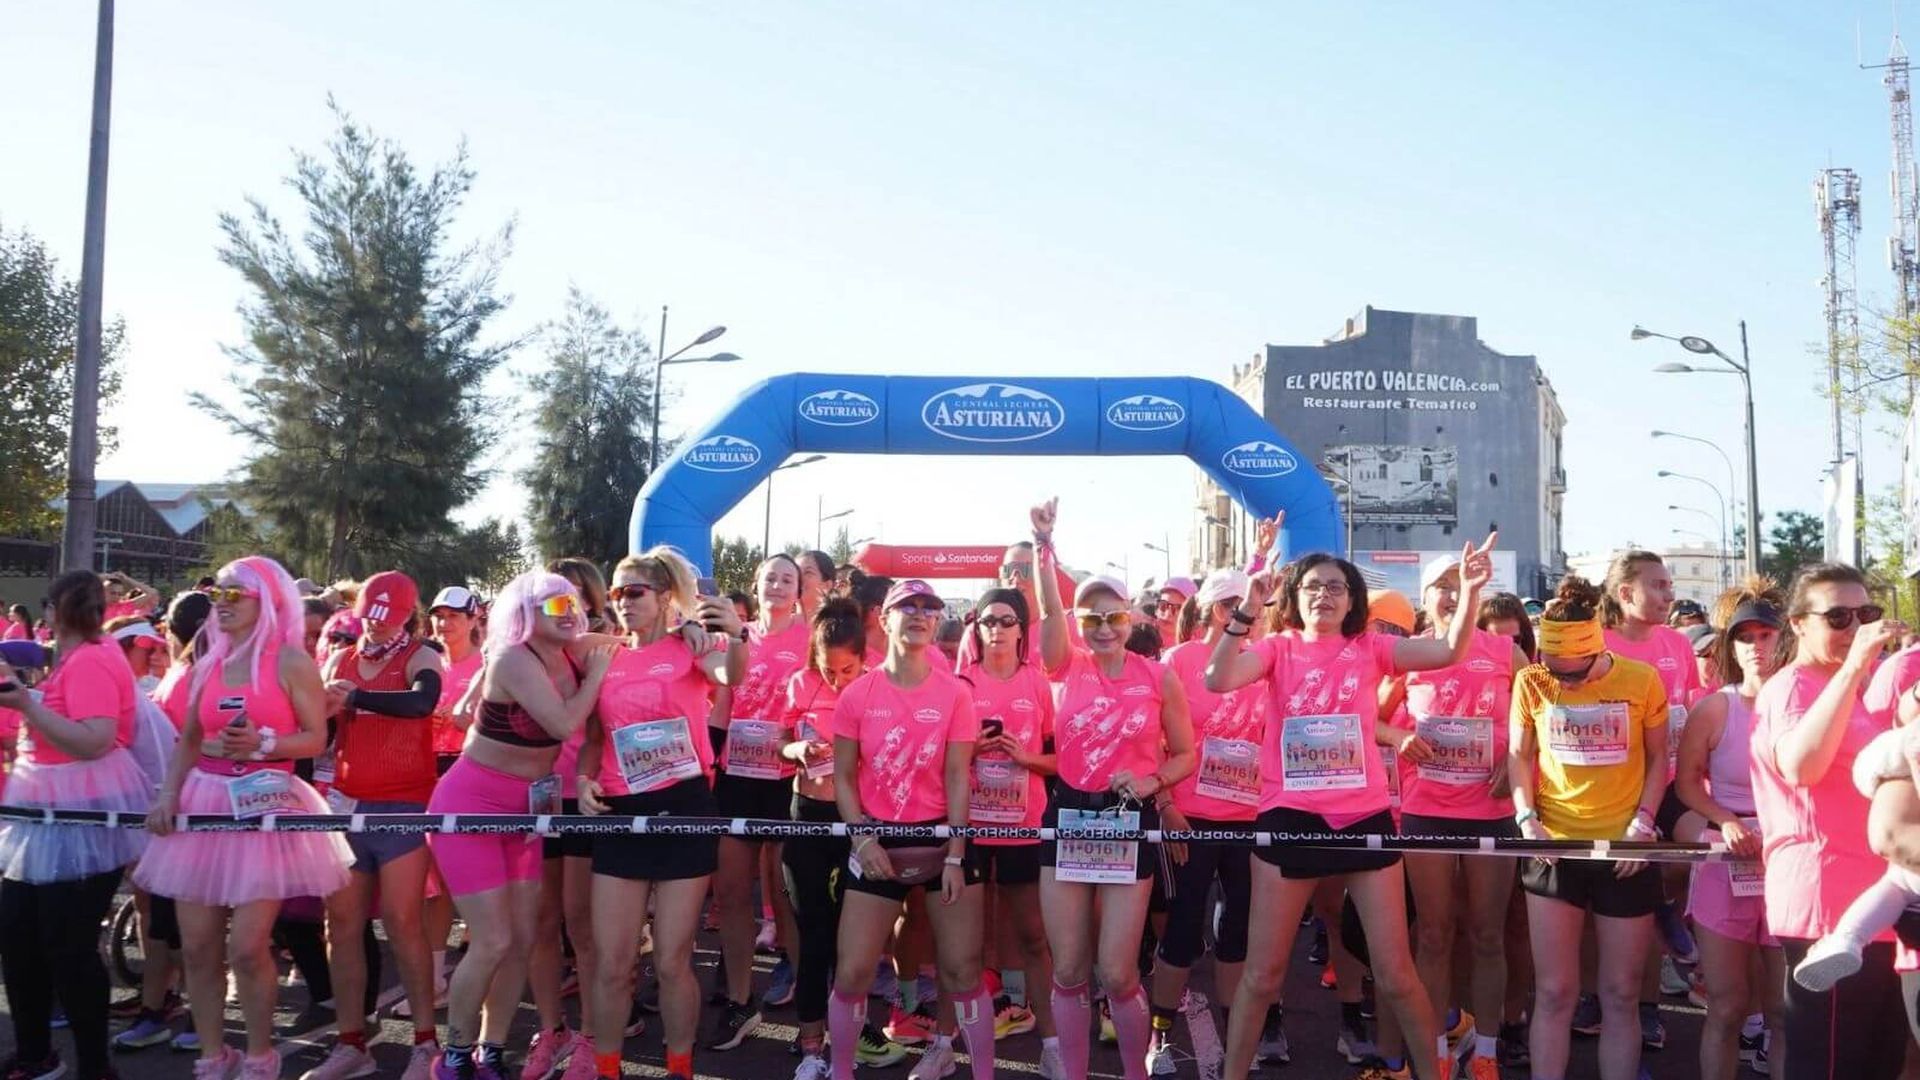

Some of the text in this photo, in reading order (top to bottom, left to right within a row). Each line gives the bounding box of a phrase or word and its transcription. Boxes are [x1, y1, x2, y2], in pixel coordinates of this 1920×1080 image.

[1286, 370, 1500, 392] EL PUERTO VALENCIA.com
[805, 401, 873, 417] ASTURIANA
[954, 400, 1000, 408] CENTRAL
[1303, 397, 1477, 410] Restaurante Tematico
[932, 401, 1054, 427] ASTURIANA
[1112, 407, 1179, 422] ASTURIANA
[687, 449, 754, 463] ASTURIANA
[1228, 453, 1294, 469] ASTURIANA
[902, 552, 999, 566] Sports Santander
[1308, 748, 1339, 761] 016
